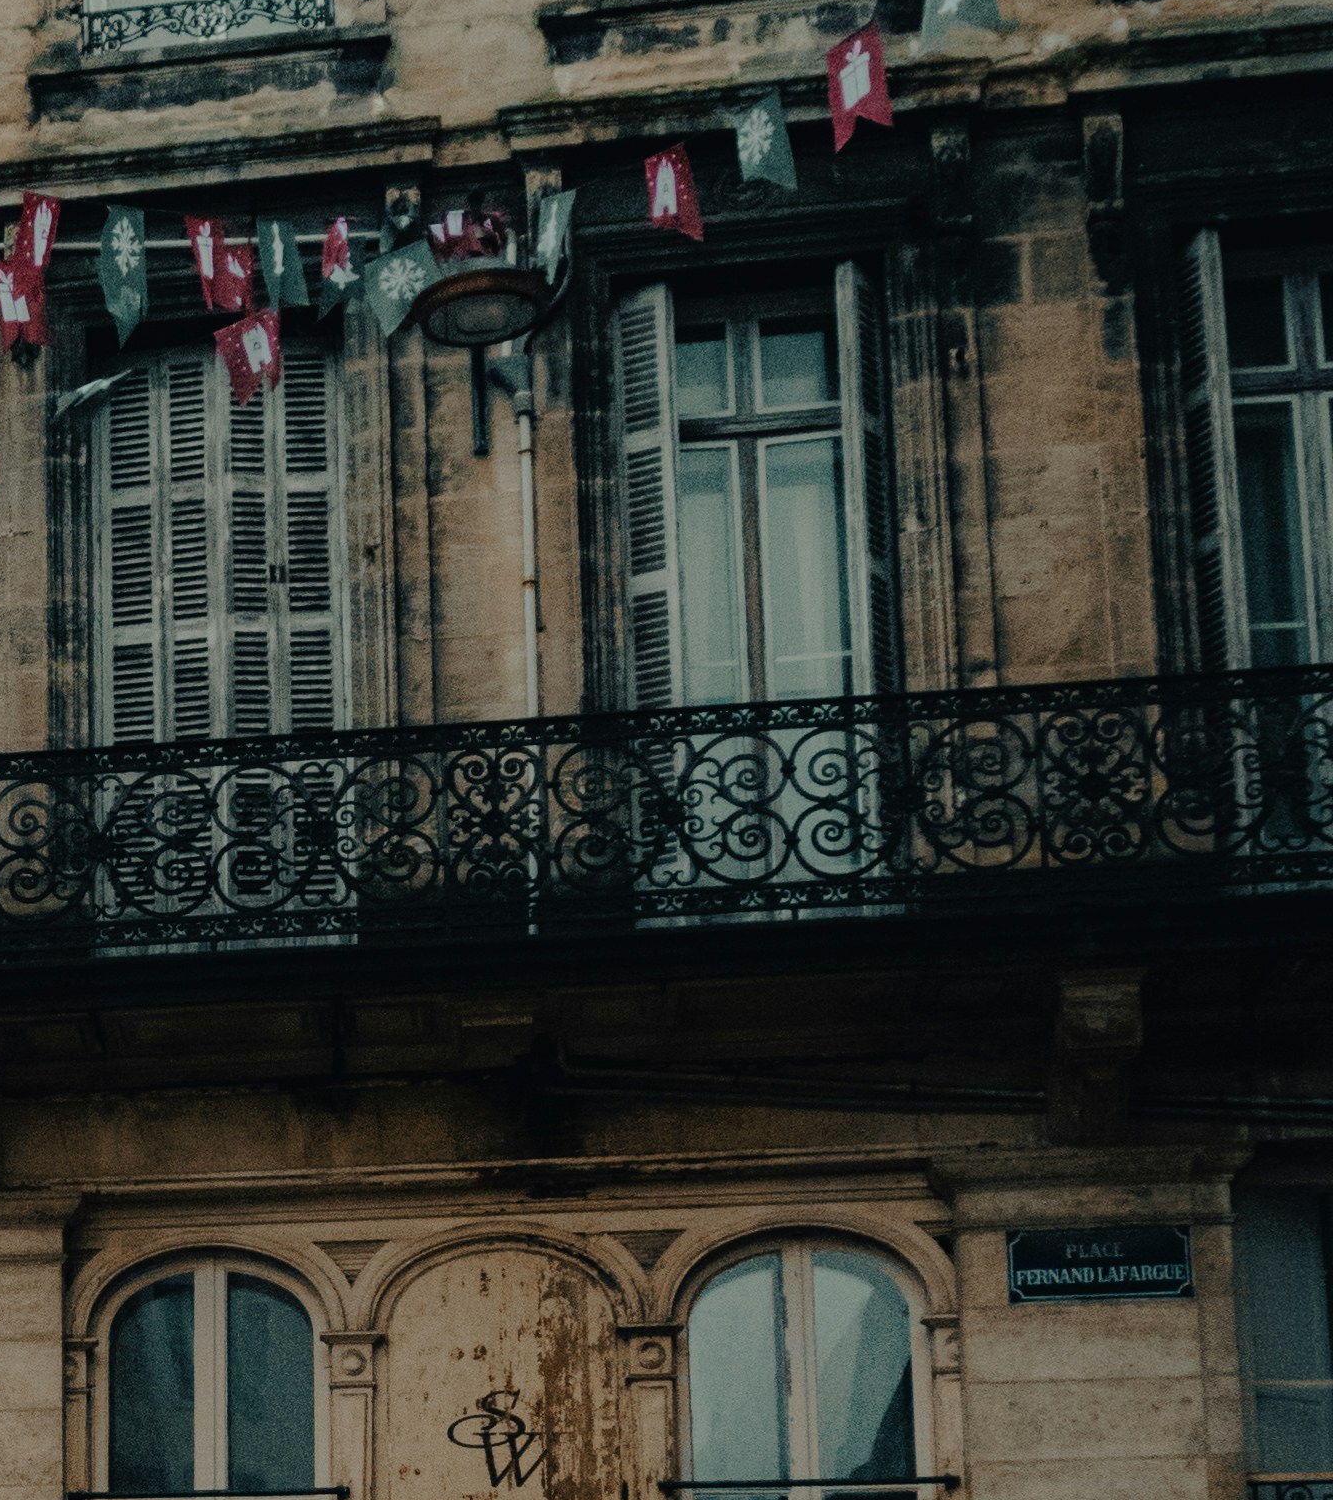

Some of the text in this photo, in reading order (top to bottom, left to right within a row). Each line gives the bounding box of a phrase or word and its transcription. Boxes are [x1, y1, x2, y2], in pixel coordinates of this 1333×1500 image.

[1066, 1241, 1125, 1259] PLACE
[1016, 1263, 1186, 1286] FERNAND LAFARGUE
